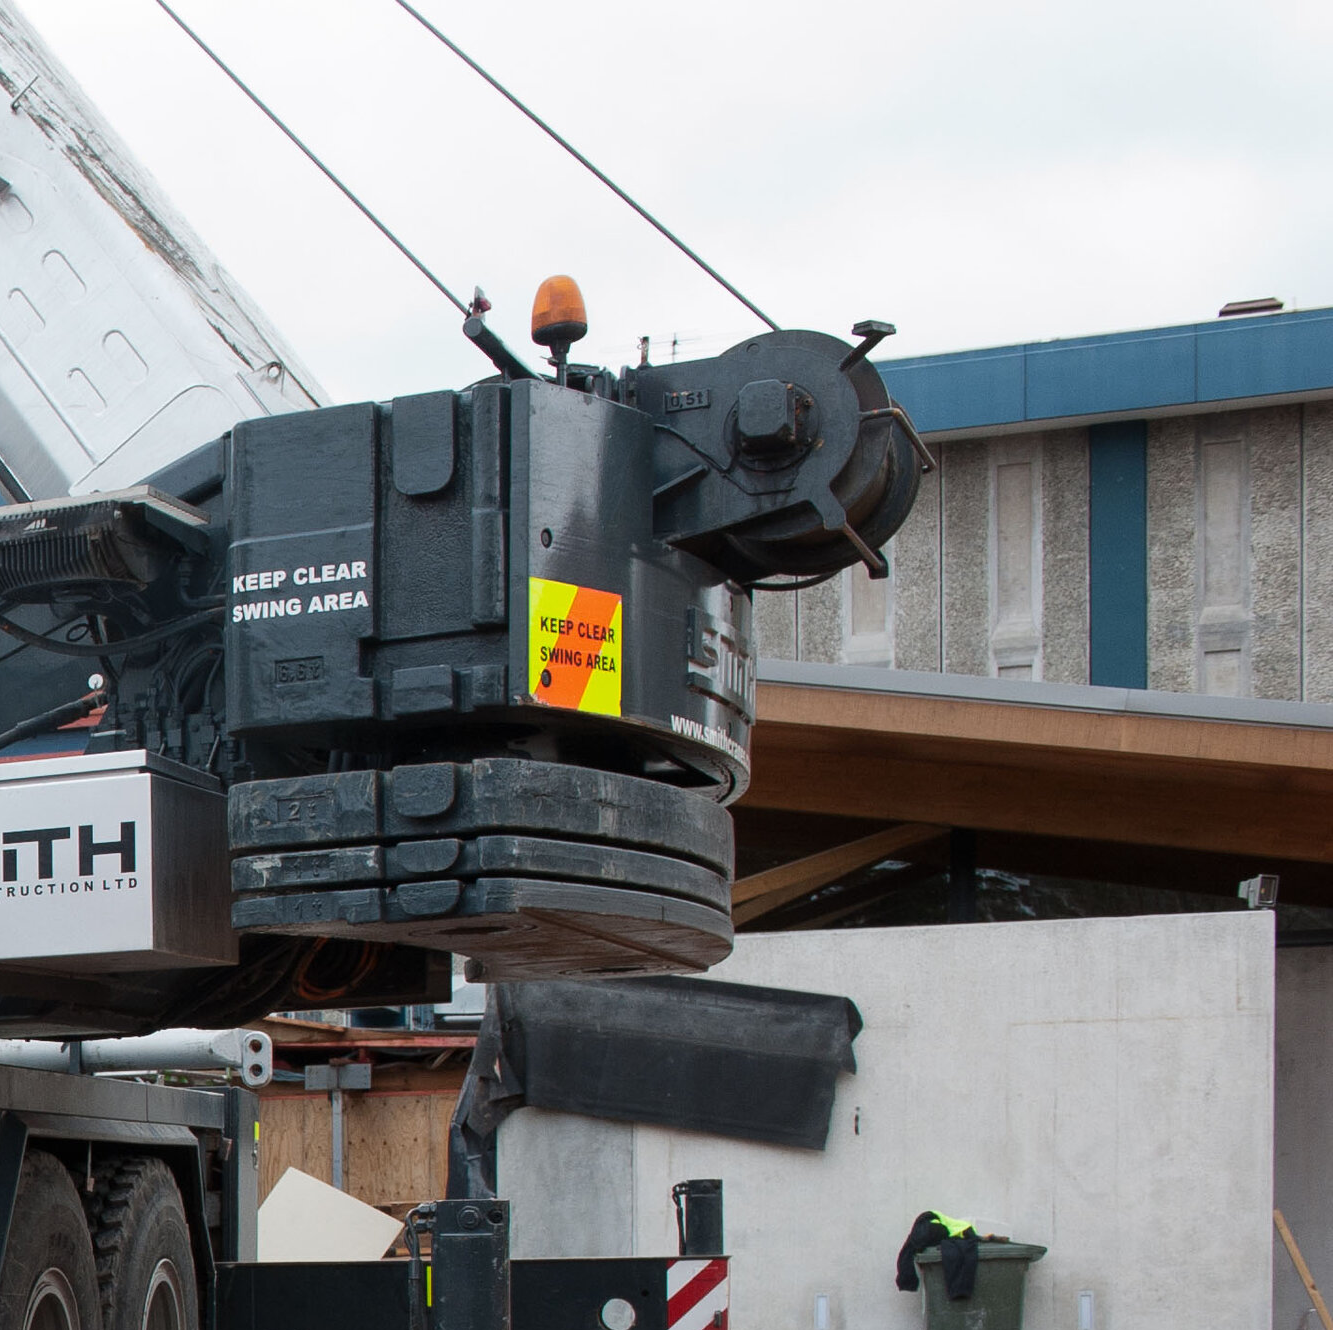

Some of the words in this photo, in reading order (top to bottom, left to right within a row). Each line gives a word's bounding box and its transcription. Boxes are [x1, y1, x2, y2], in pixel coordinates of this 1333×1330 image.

[232, 570, 287, 594] KEEP
[293, 561, 367, 585] CLEAR
[232, 596, 302, 623] SWING
[307, 591, 369, 614] AREA
[539, 616, 574, 638] KEEP
[577, 621, 616, 645] CLEAR
[539, 645, 583, 667] SWING
[585, 651, 617, 674] AREA
[102, 877, 139, 892] LTD
